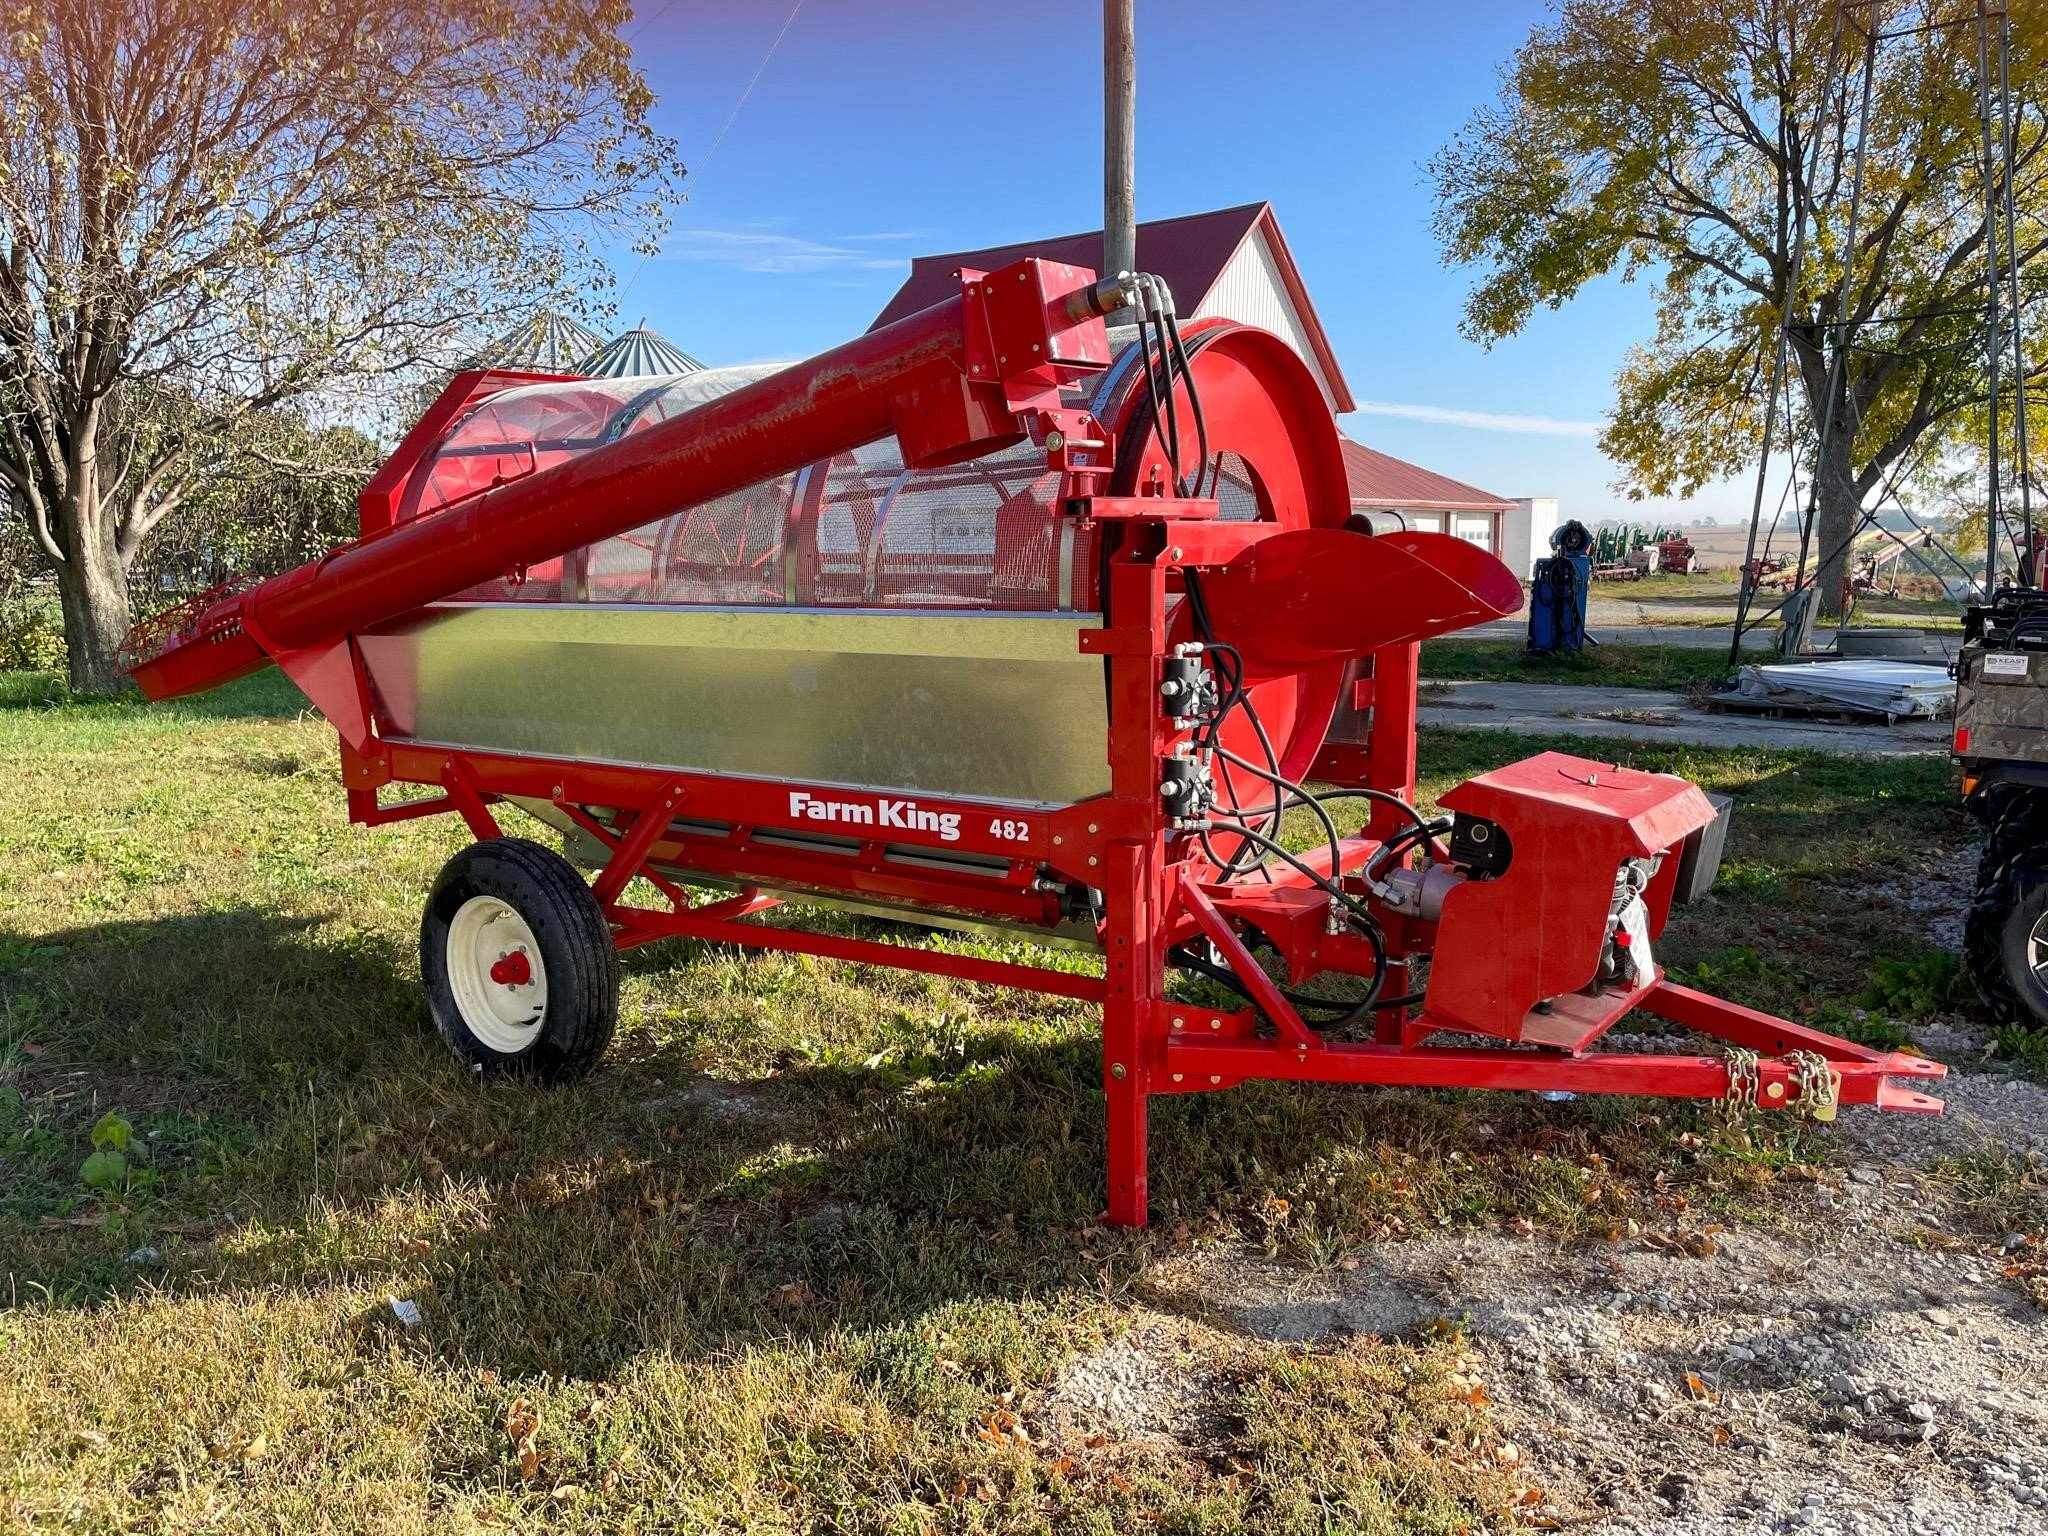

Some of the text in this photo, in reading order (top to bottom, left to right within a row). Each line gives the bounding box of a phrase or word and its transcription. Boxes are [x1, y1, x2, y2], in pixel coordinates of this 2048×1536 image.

[789, 792, 1029, 841] Farm King 482
